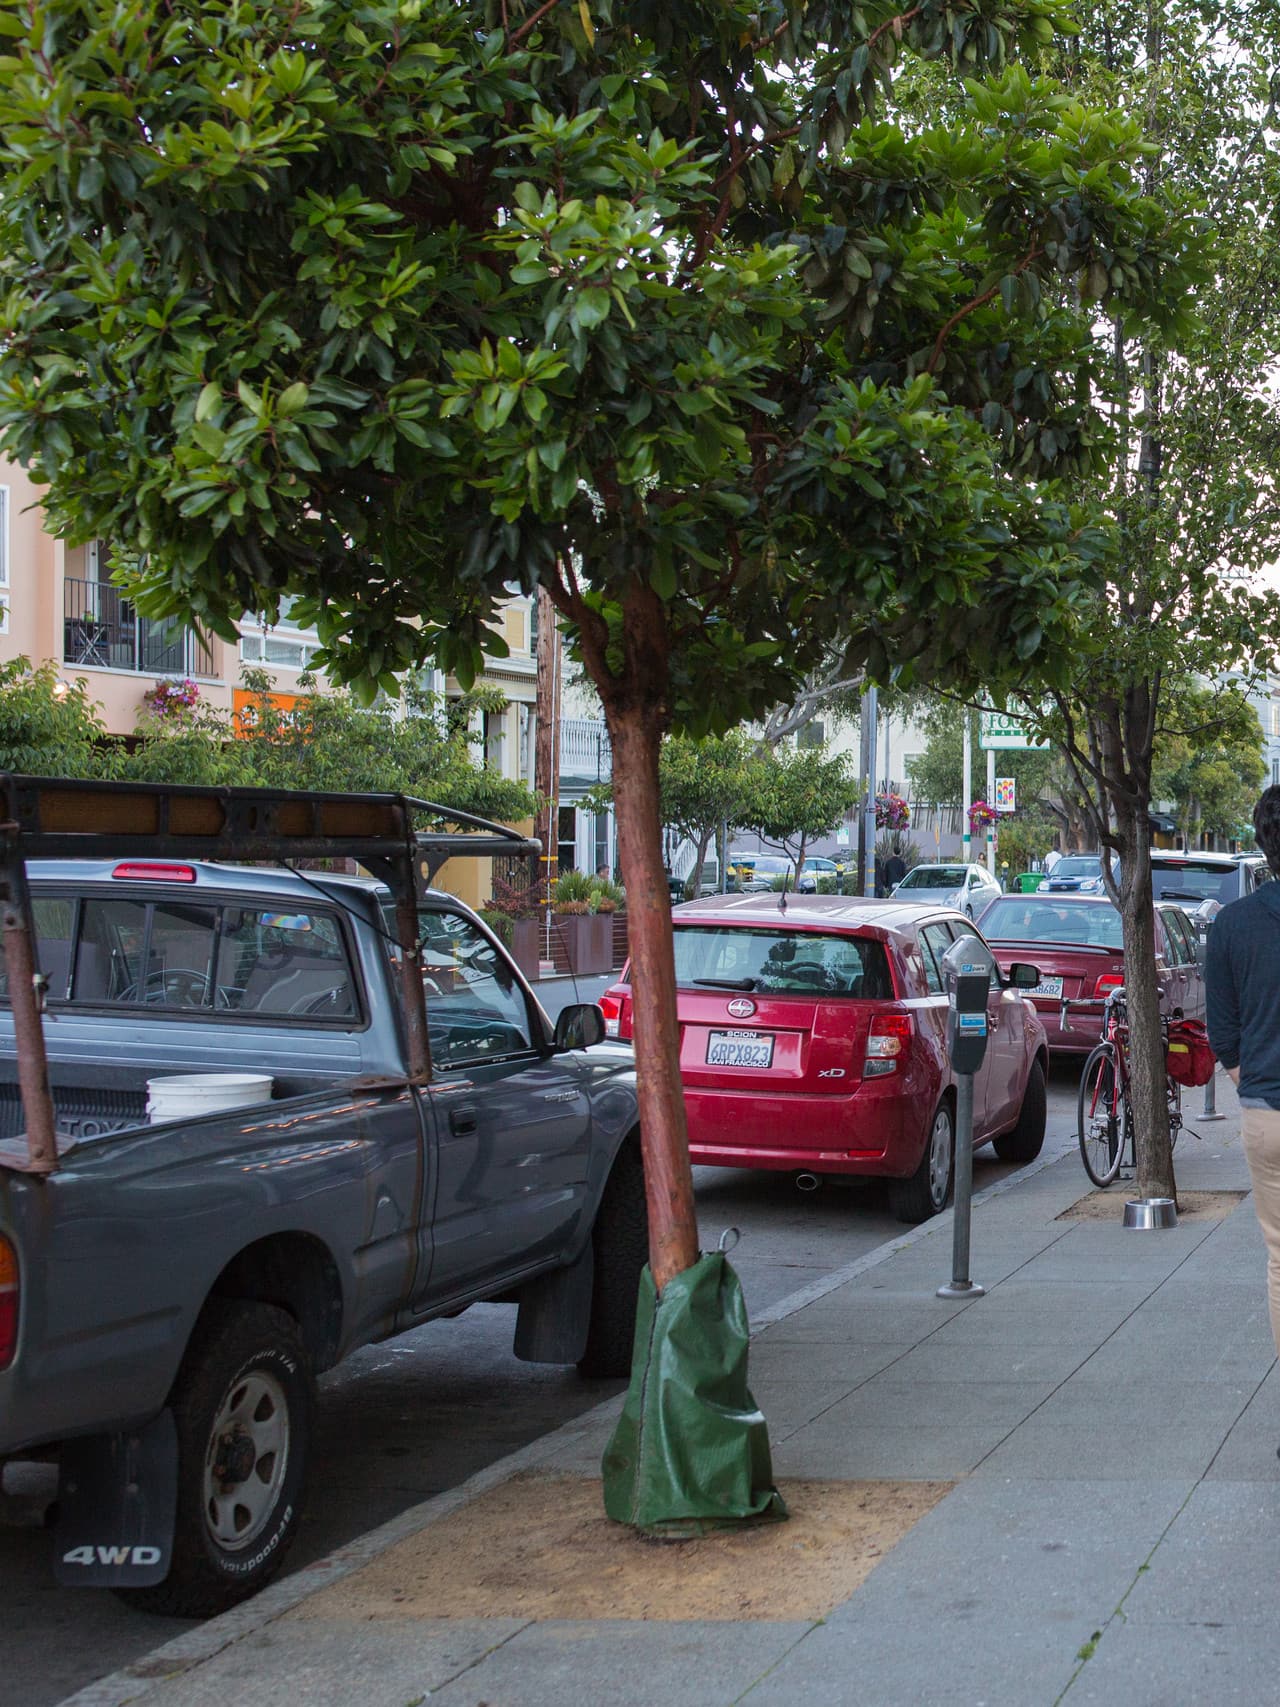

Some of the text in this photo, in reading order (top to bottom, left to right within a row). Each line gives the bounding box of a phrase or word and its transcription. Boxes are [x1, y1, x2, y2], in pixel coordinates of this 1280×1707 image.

[727, 1030, 757, 1038] SCION
[710, 1043, 770, 1062] 6RPX823
[725, 1059, 769, 1068] FRANCISCO
[818, 1068, 846, 1077] xD
[63, 1545, 161, 1565] 4WD
